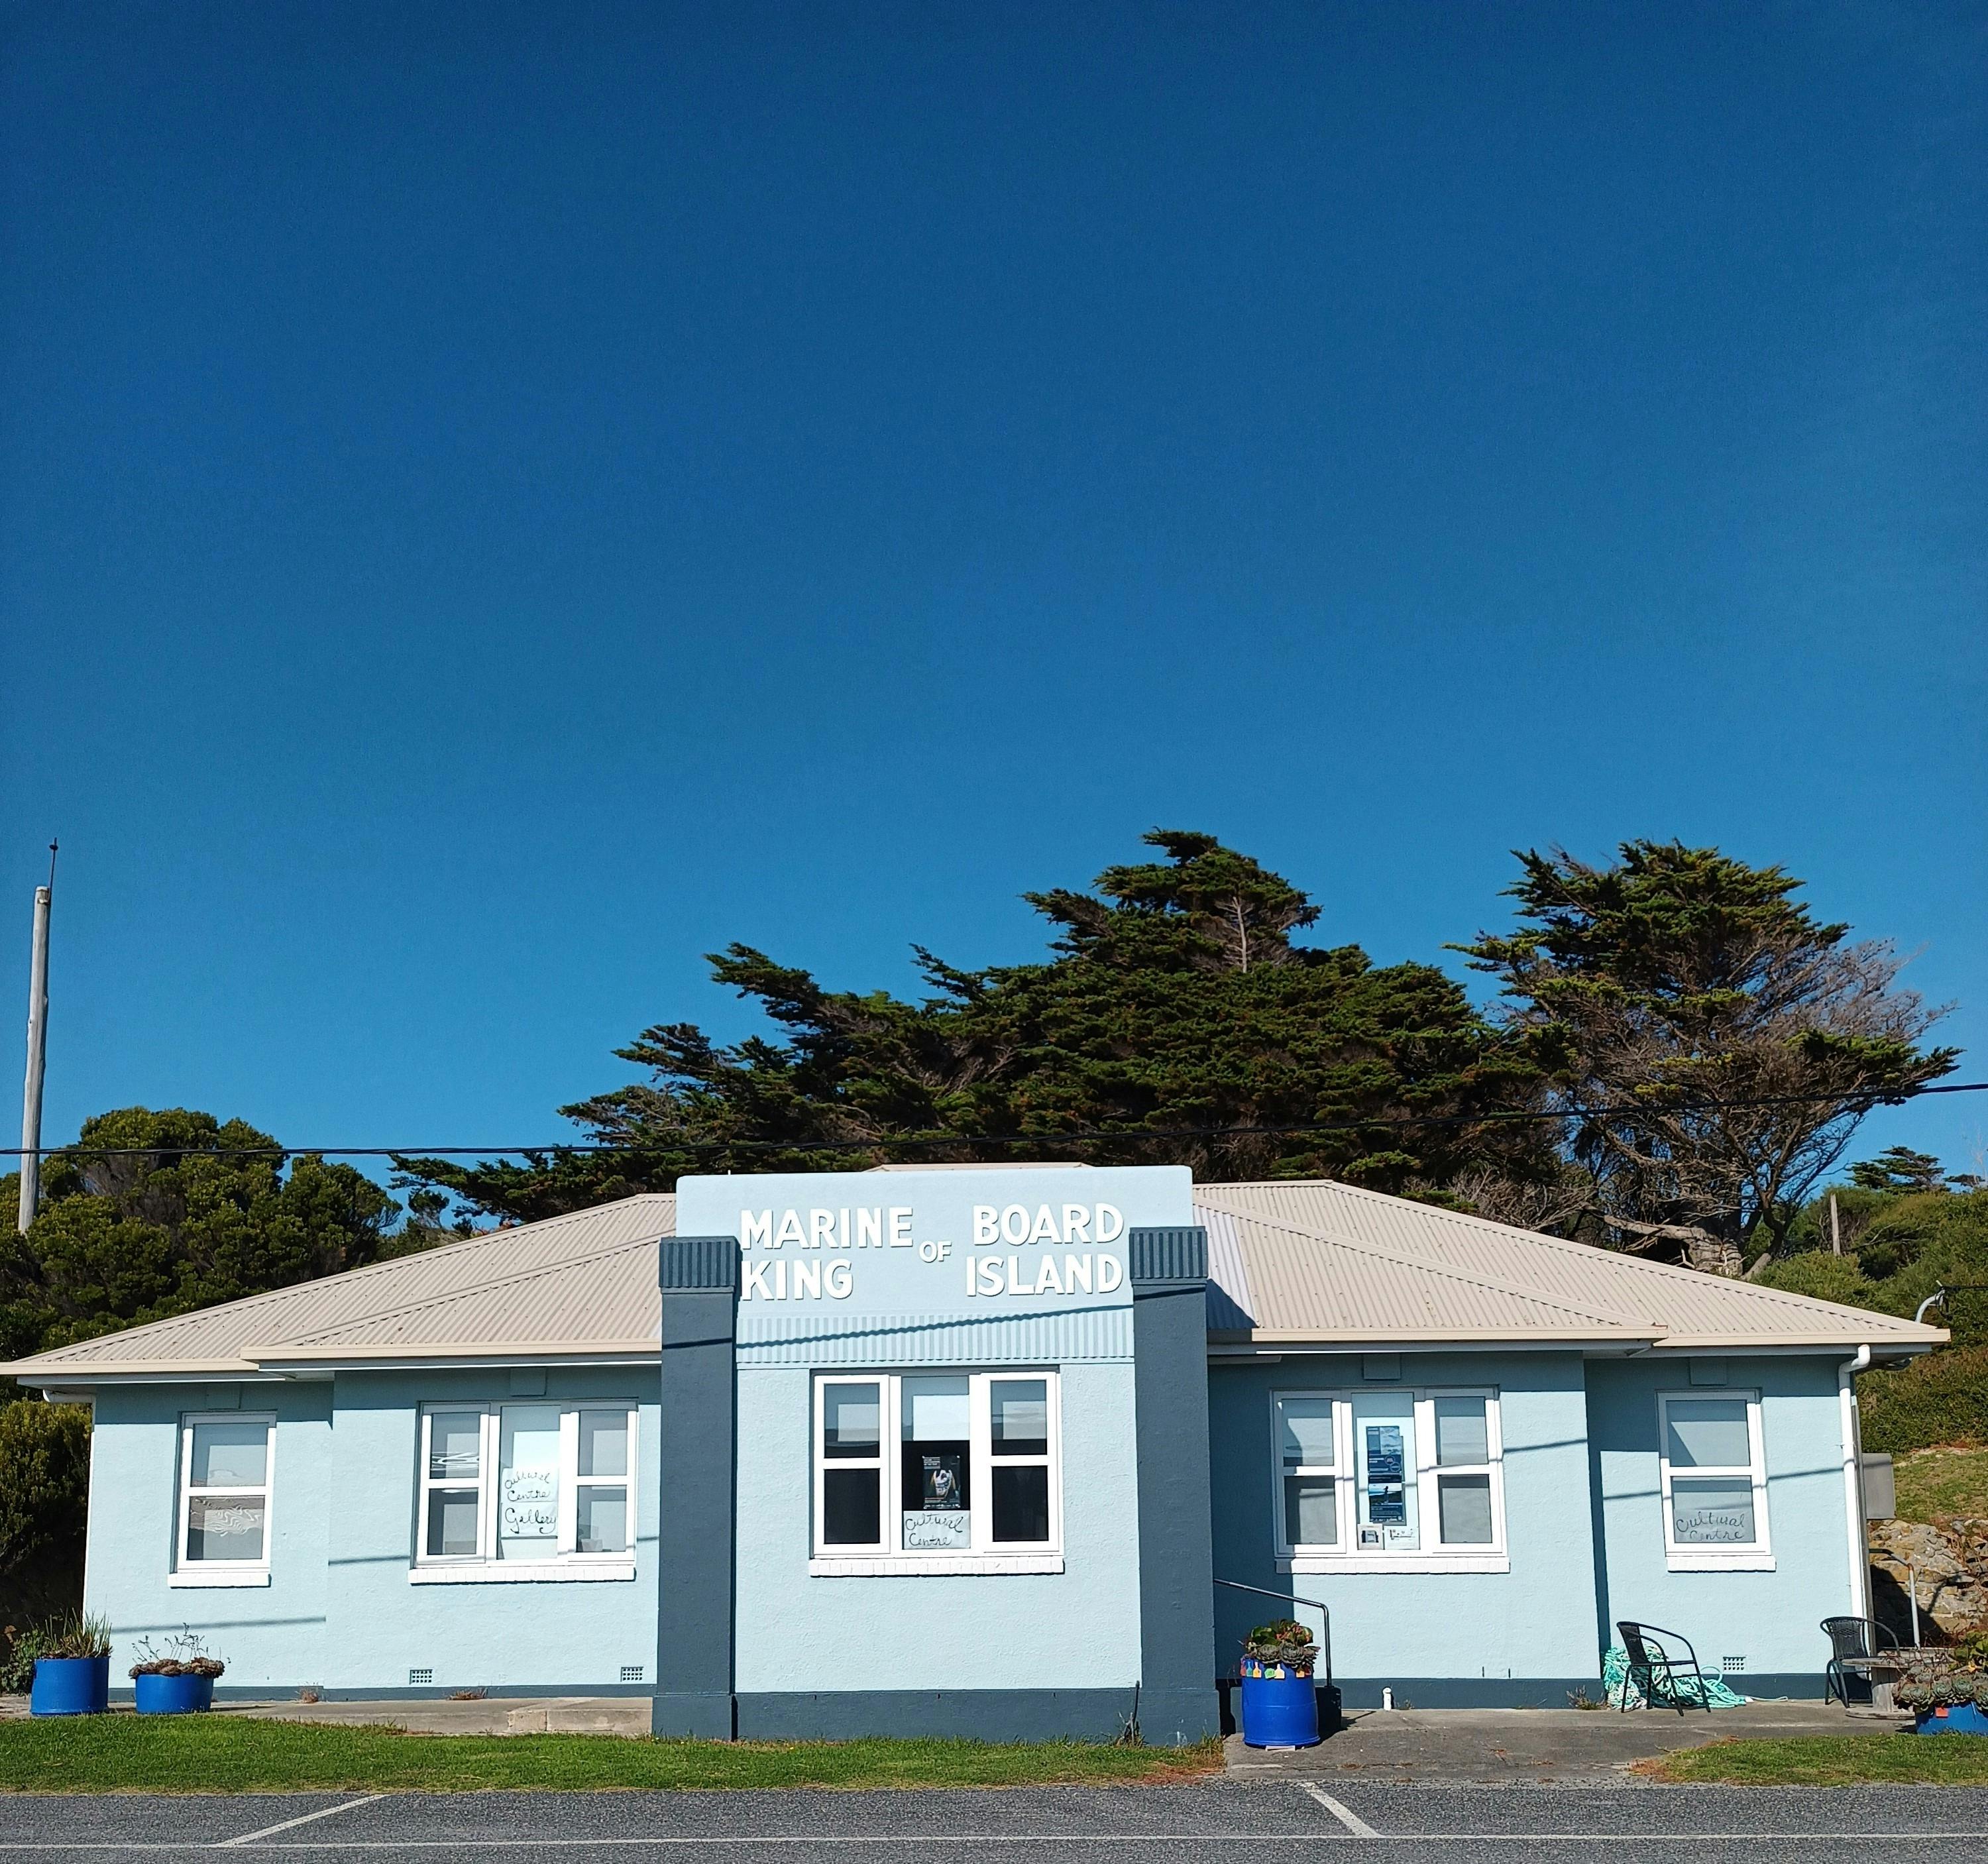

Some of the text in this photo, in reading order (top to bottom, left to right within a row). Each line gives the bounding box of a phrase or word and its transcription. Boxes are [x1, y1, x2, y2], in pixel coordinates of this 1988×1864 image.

[740, 1202, 1124, 1250] MARINE BOARD
[918, 1240, 952, 1263] OF
[740, 1254, 1124, 1301] KING ISLAND
[507, 1490, 551, 1502] Centre
[504, 1507, 557, 1535] Gallery
[1676, 1511, 1745, 1533] Cultural
[909, 1533, 952, 1546] Centre
